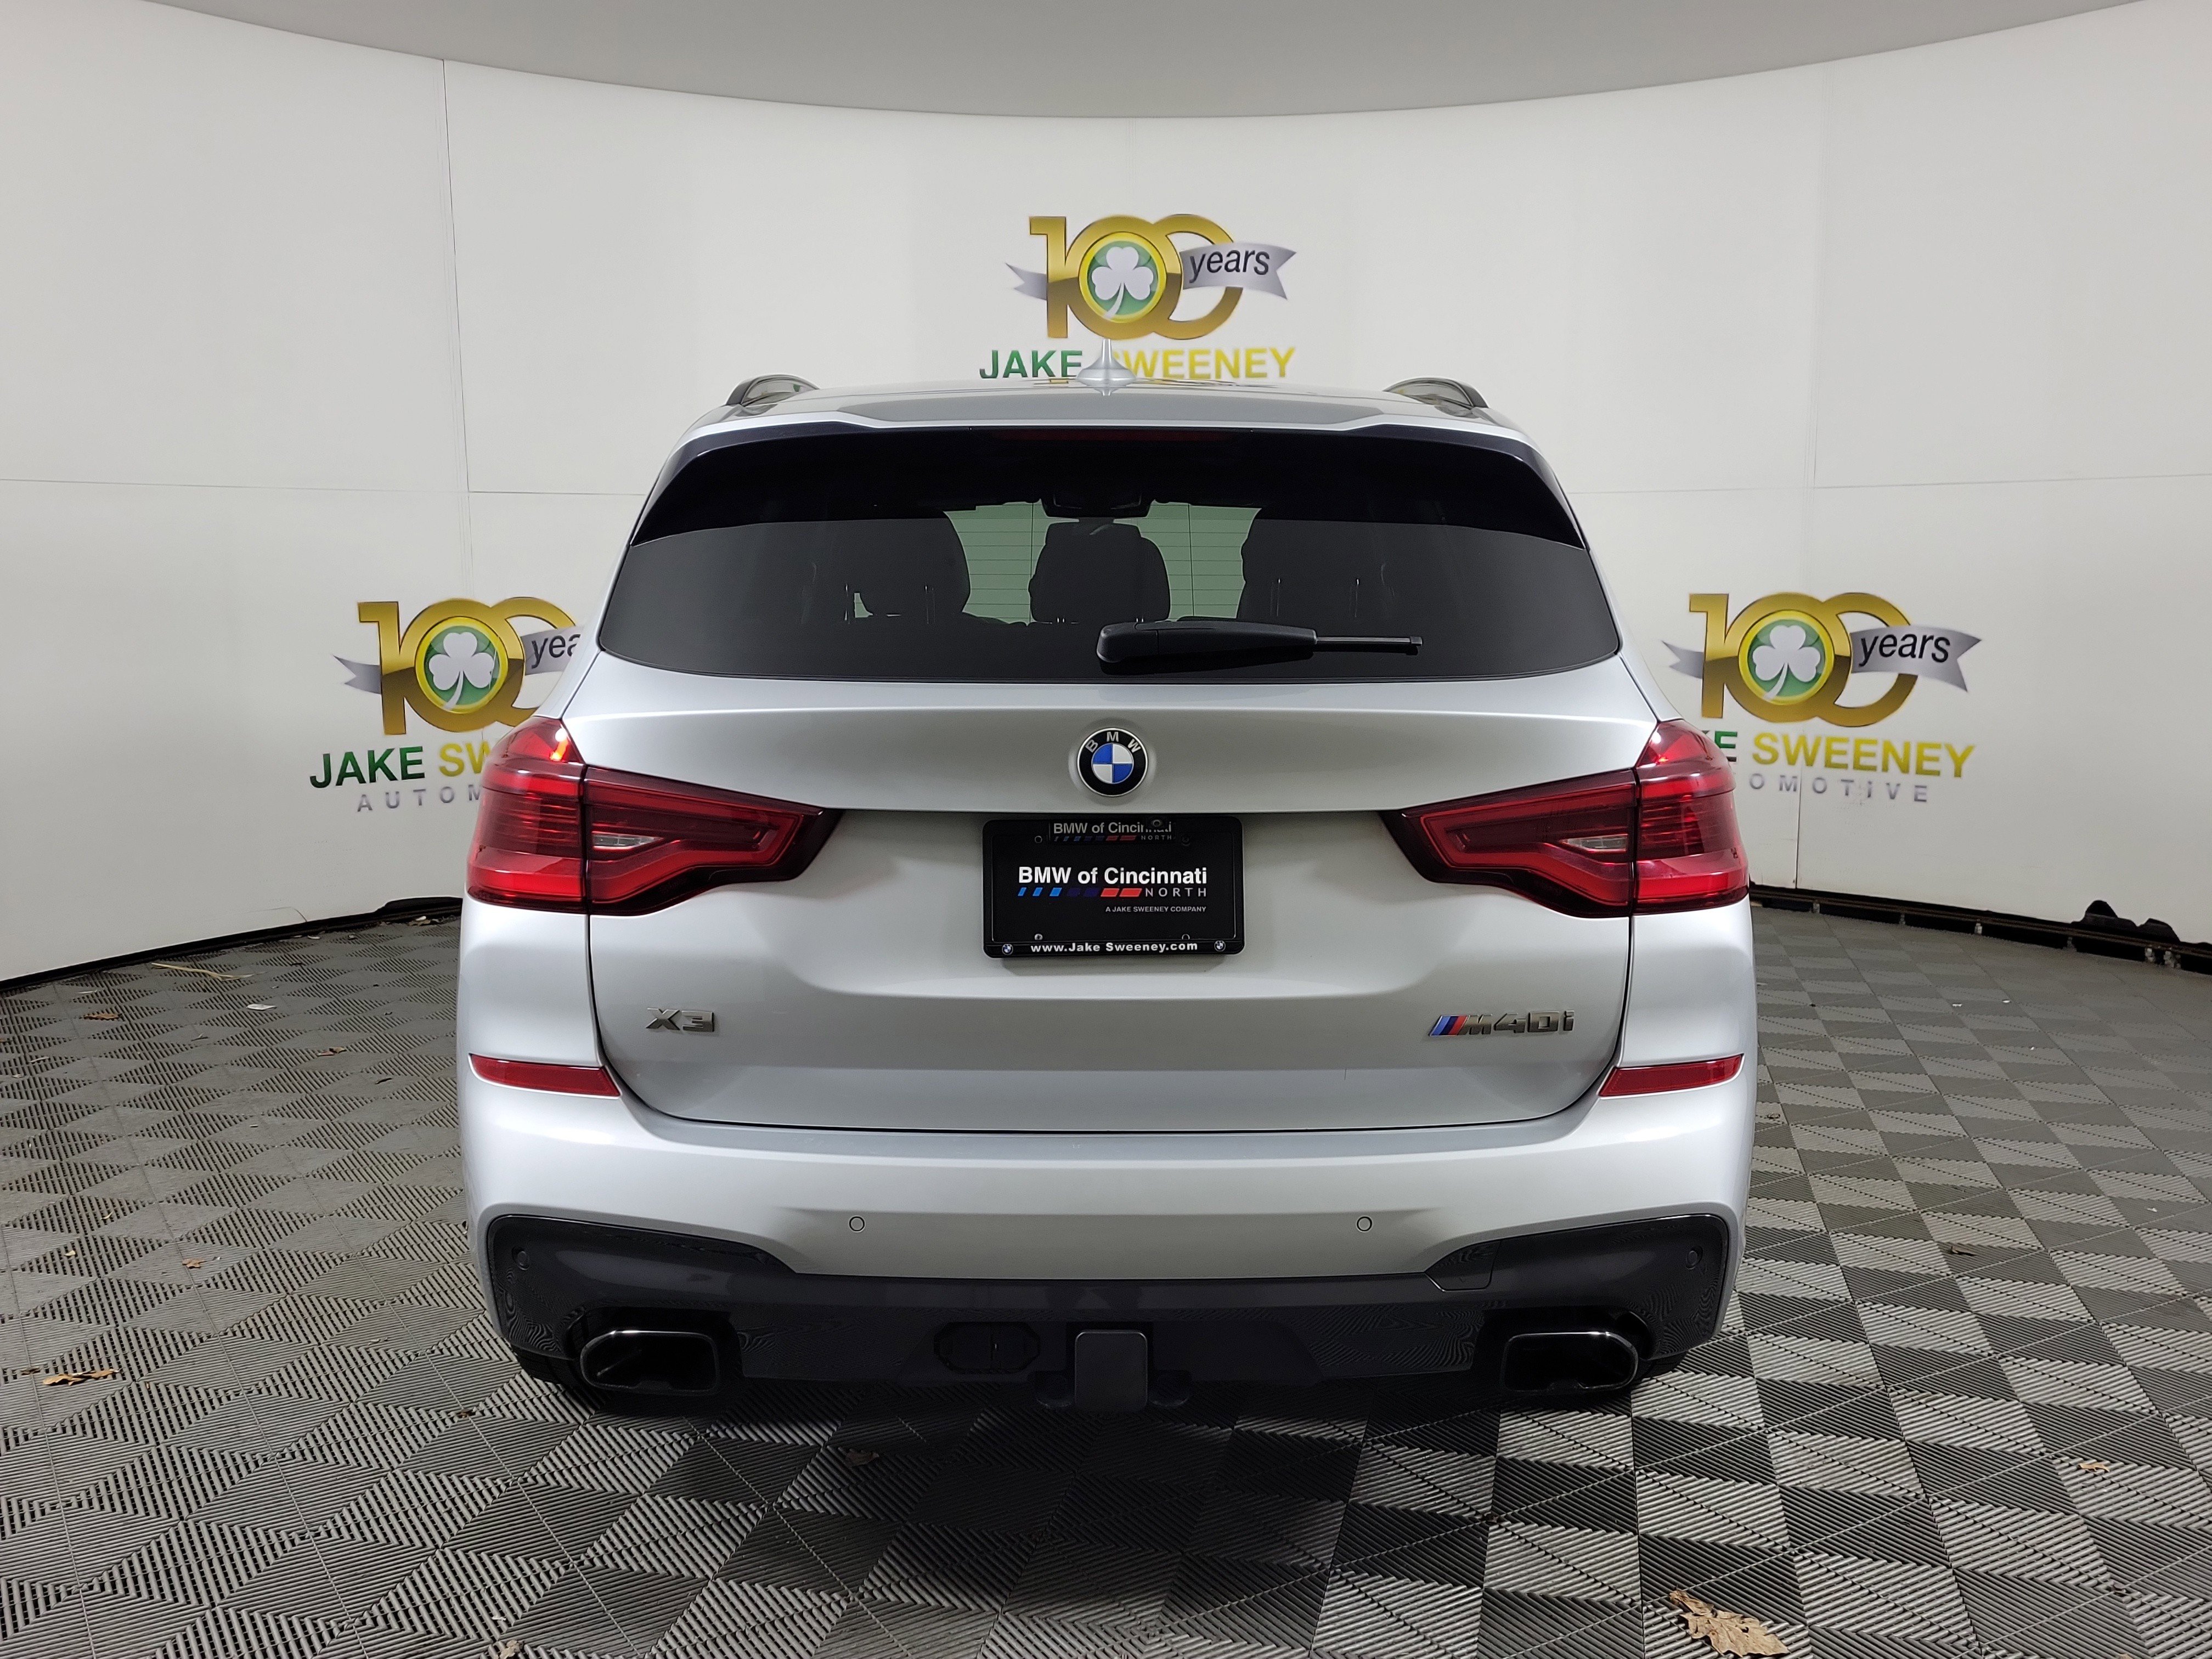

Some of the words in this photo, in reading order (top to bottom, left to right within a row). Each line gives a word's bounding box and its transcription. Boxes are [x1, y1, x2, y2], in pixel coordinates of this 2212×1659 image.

[1029, 213, 1244, 340] 100
[1188, 249, 1270, 284] years
[979, 349, 1082, 379] JAKE
[1113, 347, 1296, 379] WEENEY
[531, 634, 581, 669] yea
[1689, 592, 1918, 727] 100
[1859, 633, 1951, 667] years
[1085, 731, 1141, 753] BMW
[1752, 731, 1975, 778] SWEENEY
[309, 746, 425, 788] JAKE
[1749, 773, 1927, 803] OMOTIVE
[1053, 822, 1088, 834] BMW
[1092, 822, 1104, 833] of
[1018, 866, 1071, 884] BMW
[1077, 867, 1098, 884] of
[1104, 867, 1207, 884] Cincinnati
[1145, 888, 1207, 898] NORTH
[1030, 943, 1100, 952] www.Jake
[1105, 942, 1198, 953] Sweeney.com
[645, 1007, 715, 1032] X3
[1456, 1010, 1575, 1036] M40i
